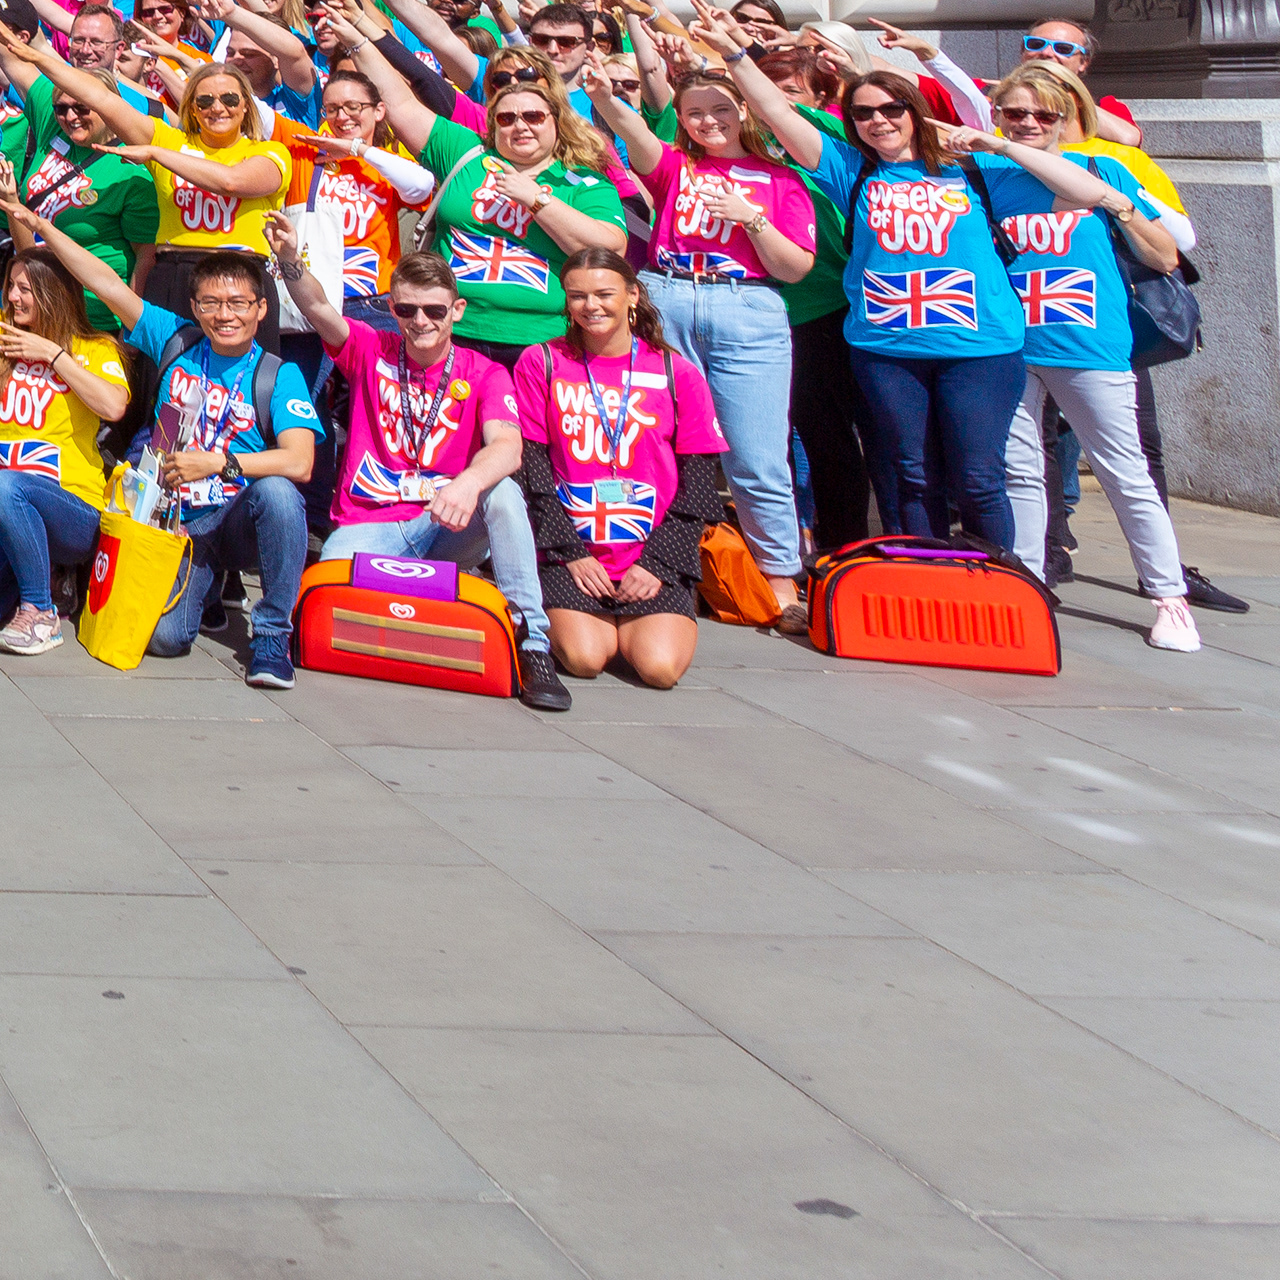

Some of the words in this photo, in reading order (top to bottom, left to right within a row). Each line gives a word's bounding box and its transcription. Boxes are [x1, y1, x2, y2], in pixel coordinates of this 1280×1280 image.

[184, 190, 238, 232] JOY
[677, 206, 739, 246] JOY
[881, 208, 951, 254] JOY
[1017, 211, 1075, 254] JOY
[571, 415, 642, 468] JOY
